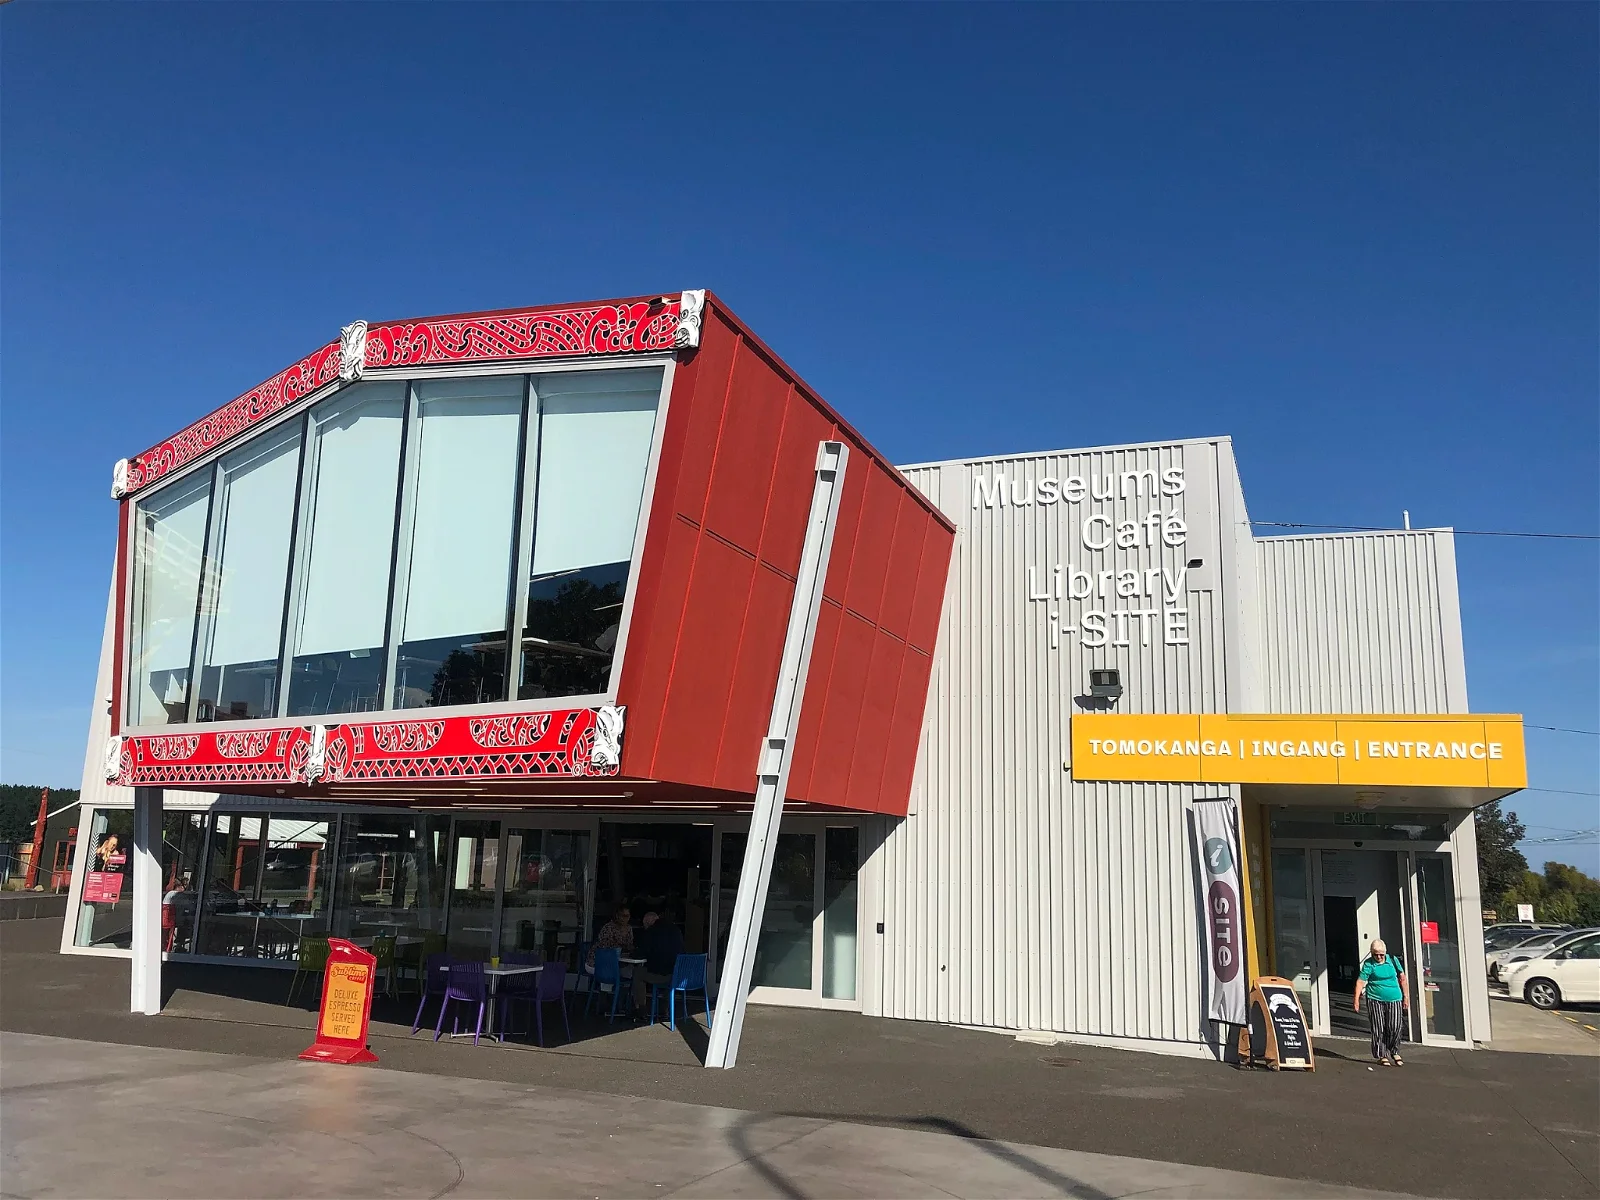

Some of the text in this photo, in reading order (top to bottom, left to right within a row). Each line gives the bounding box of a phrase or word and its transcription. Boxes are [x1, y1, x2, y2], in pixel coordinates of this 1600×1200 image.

[973, 467, 1186, 509] Museums
[1082, 508, 1188, 549] Café
[1029, 564, 1188, 603] Library
[1050, 608, 1189, 648] i-SITE
[1089, 739, 1232, 756] TOMOKANGA
[1251, 740, 1346, 758] INGANG
[1368, 741, 1503, 759] ENTRANCE
[1344, 812, 1366, 823] EXIT
[334, 988, 359, 1000] DELUXE
[329, 1000, 361, 1012] ESPRESSO
[331, 1012, 355, 1024] SERVED
[333, 1024, 351, 1035] HERE
